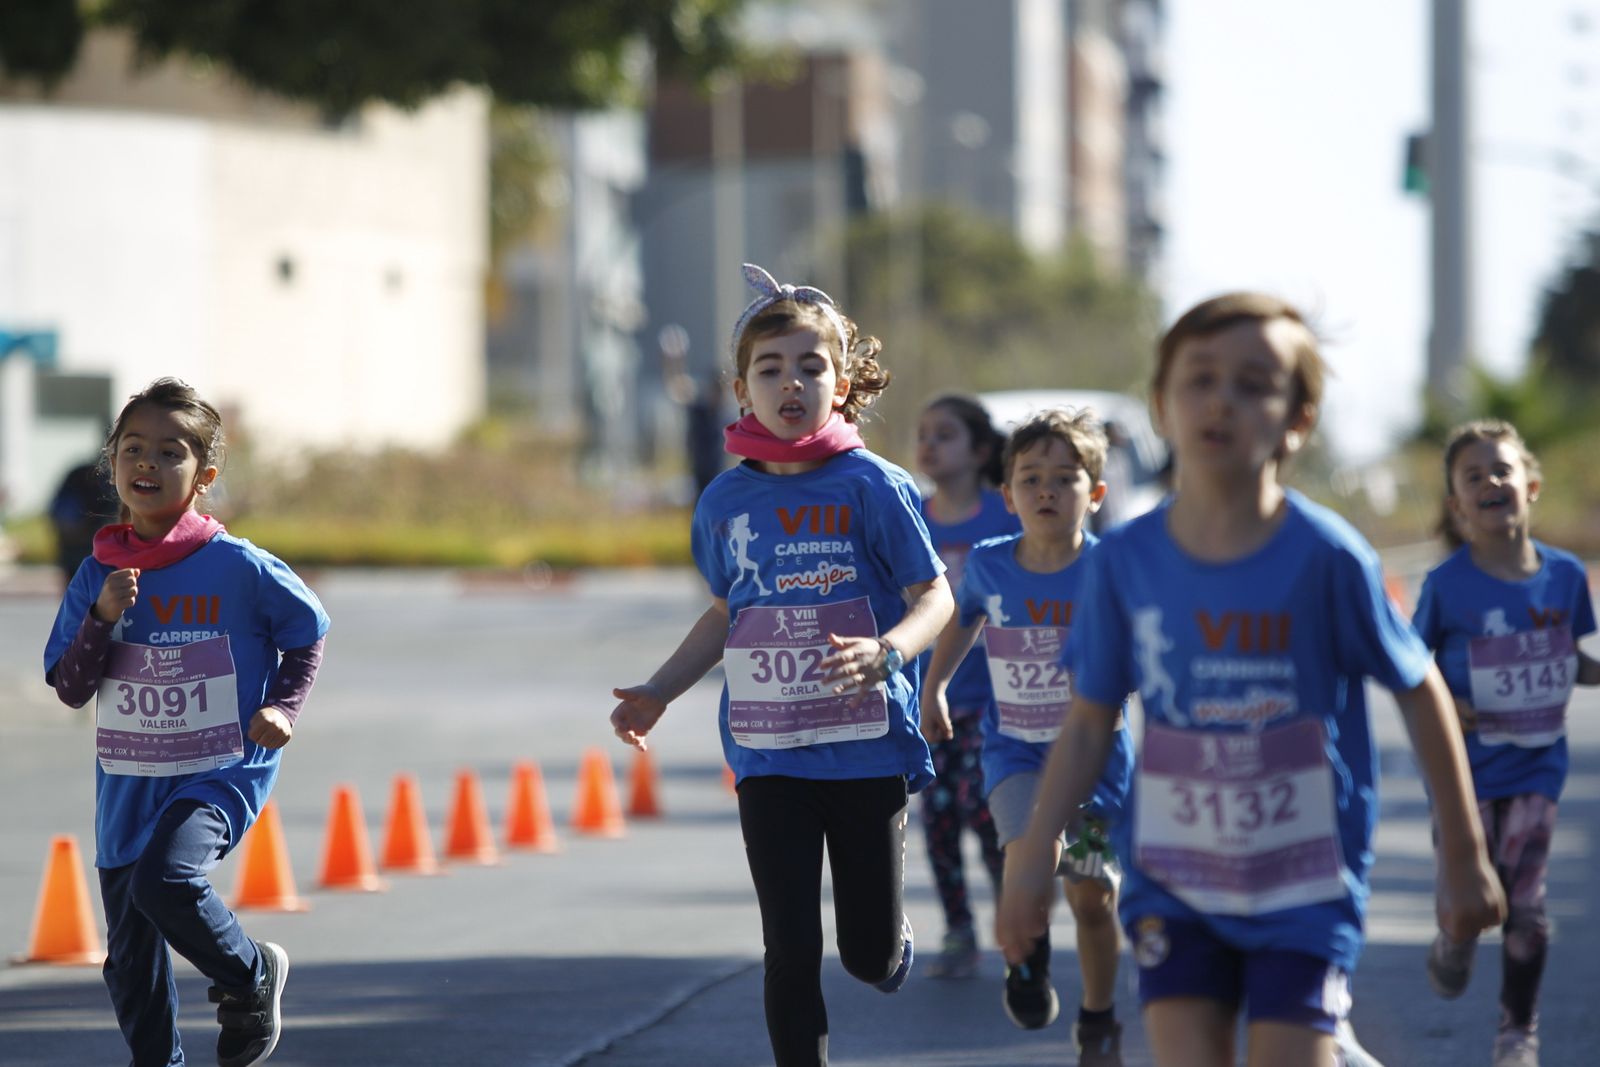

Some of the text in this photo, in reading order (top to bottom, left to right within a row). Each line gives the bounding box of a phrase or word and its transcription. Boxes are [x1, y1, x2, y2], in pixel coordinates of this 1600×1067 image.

[776, 505, 850, 536] VIII
[775, 541, 853, 555] CARRERA
[150, 596, 219, 624] VIII
[792, 609, 817, 620] VIII
[149, 631, 219, 643] CARRERA
[1196, 611, 1290, 651] VIII
[158, 649, 181, 660] VIII
[750, 645, 842, 684] 302
[780, 684, 821, 696] CARLA
[1495, 661, 1568, 698] 3143
[117, 681, 208, 718] 3091
[139, 718, 187, 729] VALERIA
[1169, 781, 1297, 831] 3132
